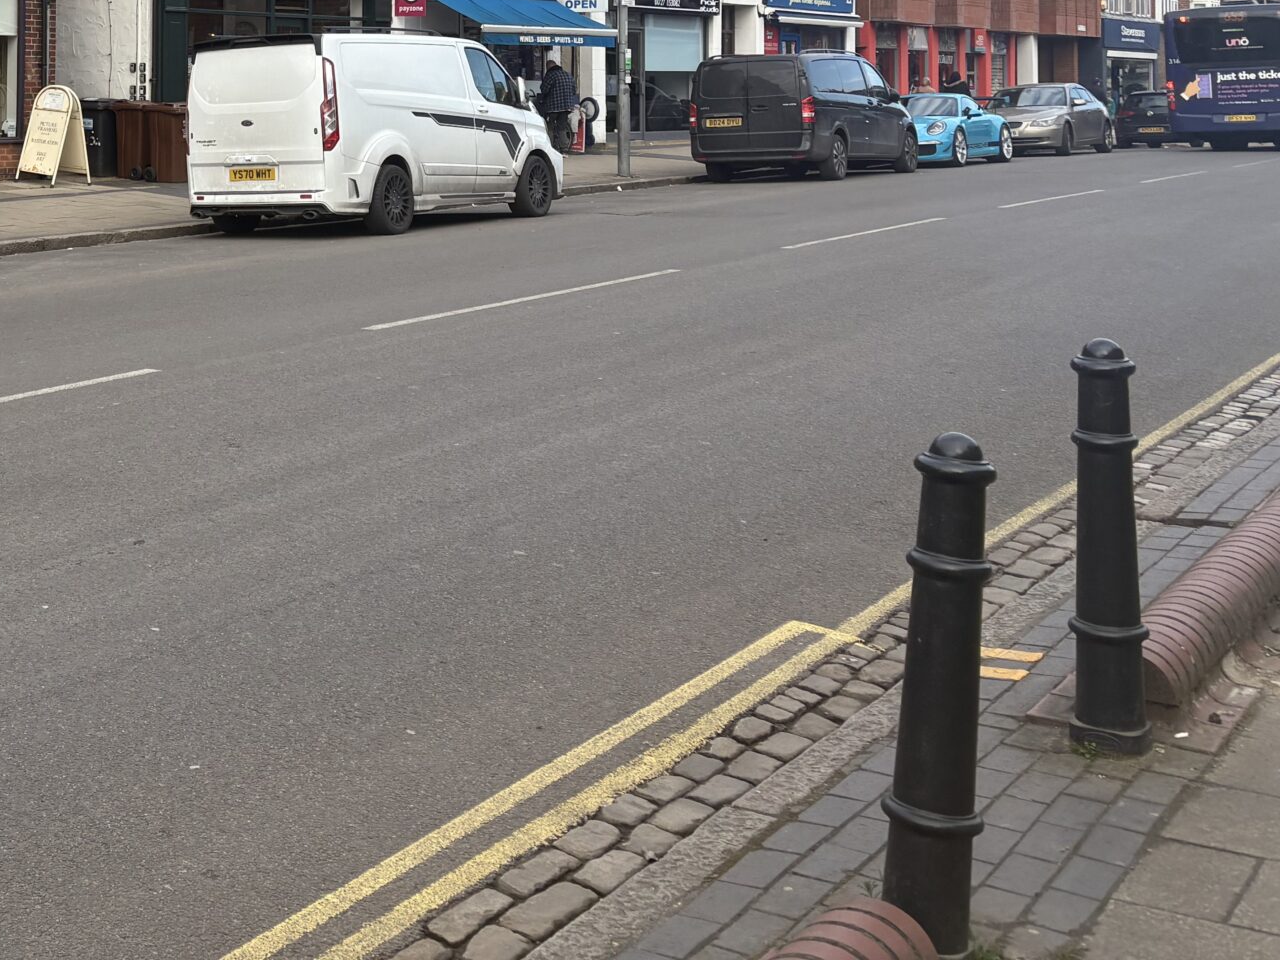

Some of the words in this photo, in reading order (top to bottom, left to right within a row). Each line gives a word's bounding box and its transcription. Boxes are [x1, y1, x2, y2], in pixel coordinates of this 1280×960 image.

[398, 5, 424, 13] payzone
[565, 0, 597, 9] OPEN
[1216, 72, 1237, 83] just
[1238, 71, 1256, 80] the
[232, 169, 254, 180] YS70
[255, 168, 272, 178] WHT
